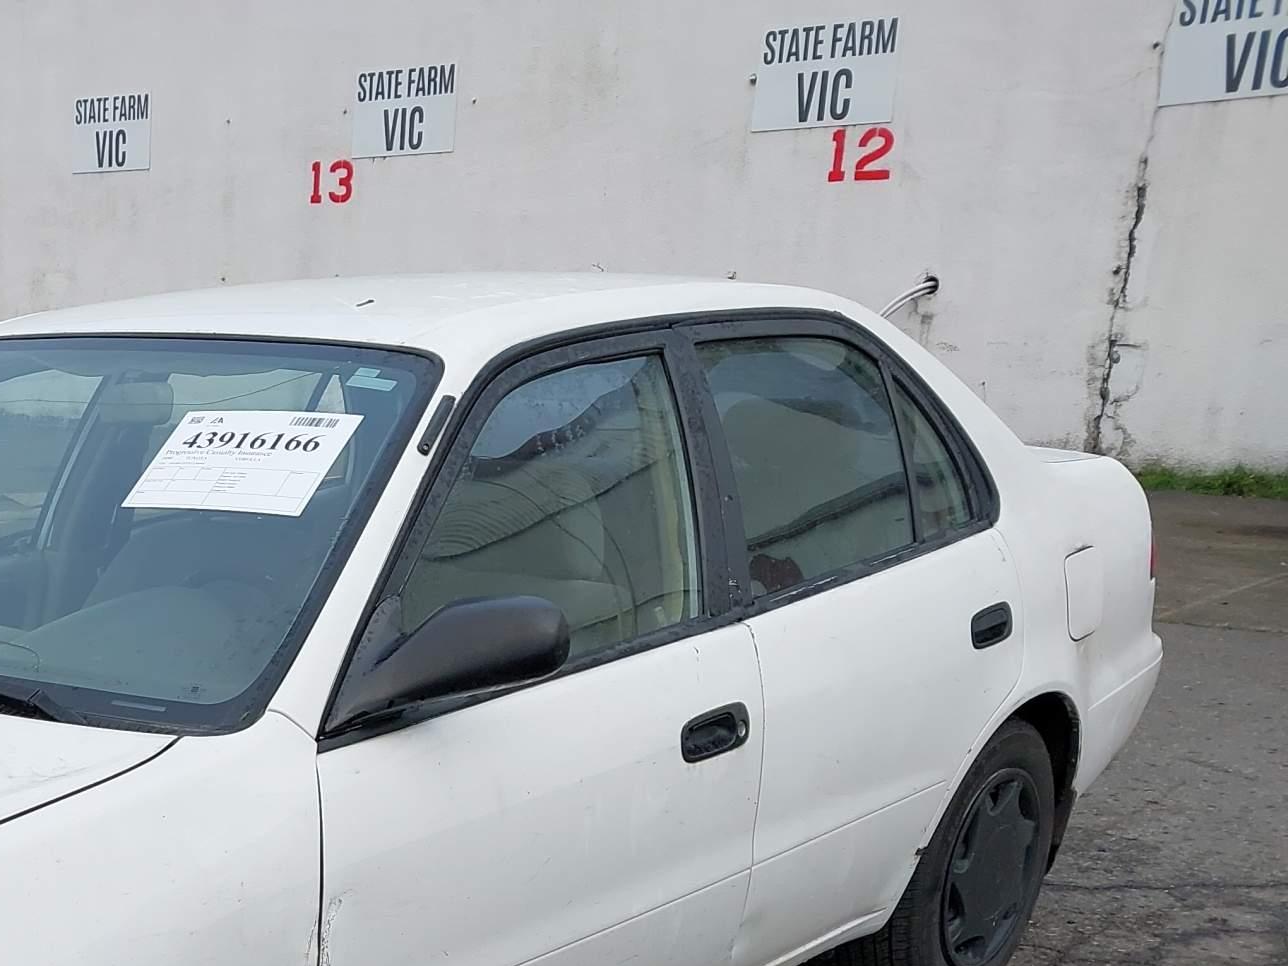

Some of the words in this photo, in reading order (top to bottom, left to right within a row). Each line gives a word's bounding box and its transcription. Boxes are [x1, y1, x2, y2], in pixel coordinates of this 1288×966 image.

[763, 25, 826, 65] STATE
[830, 17, 898, 59] FARM
[357, 69, 403, 102] STATE
[407, 63, 455, 98] FARM
[797, 68, 853, 123] VIC
[75, 97, 110, 125] STATE
[112, 93, 149, 122] FARM
[383, 105, 424, 152] VIC
[95, 129, 127, 168] VIC
[827, 127, 895, 182] 12
[310, 159, 354, 204] 13
[182, 431, 326, 453] 43916166
